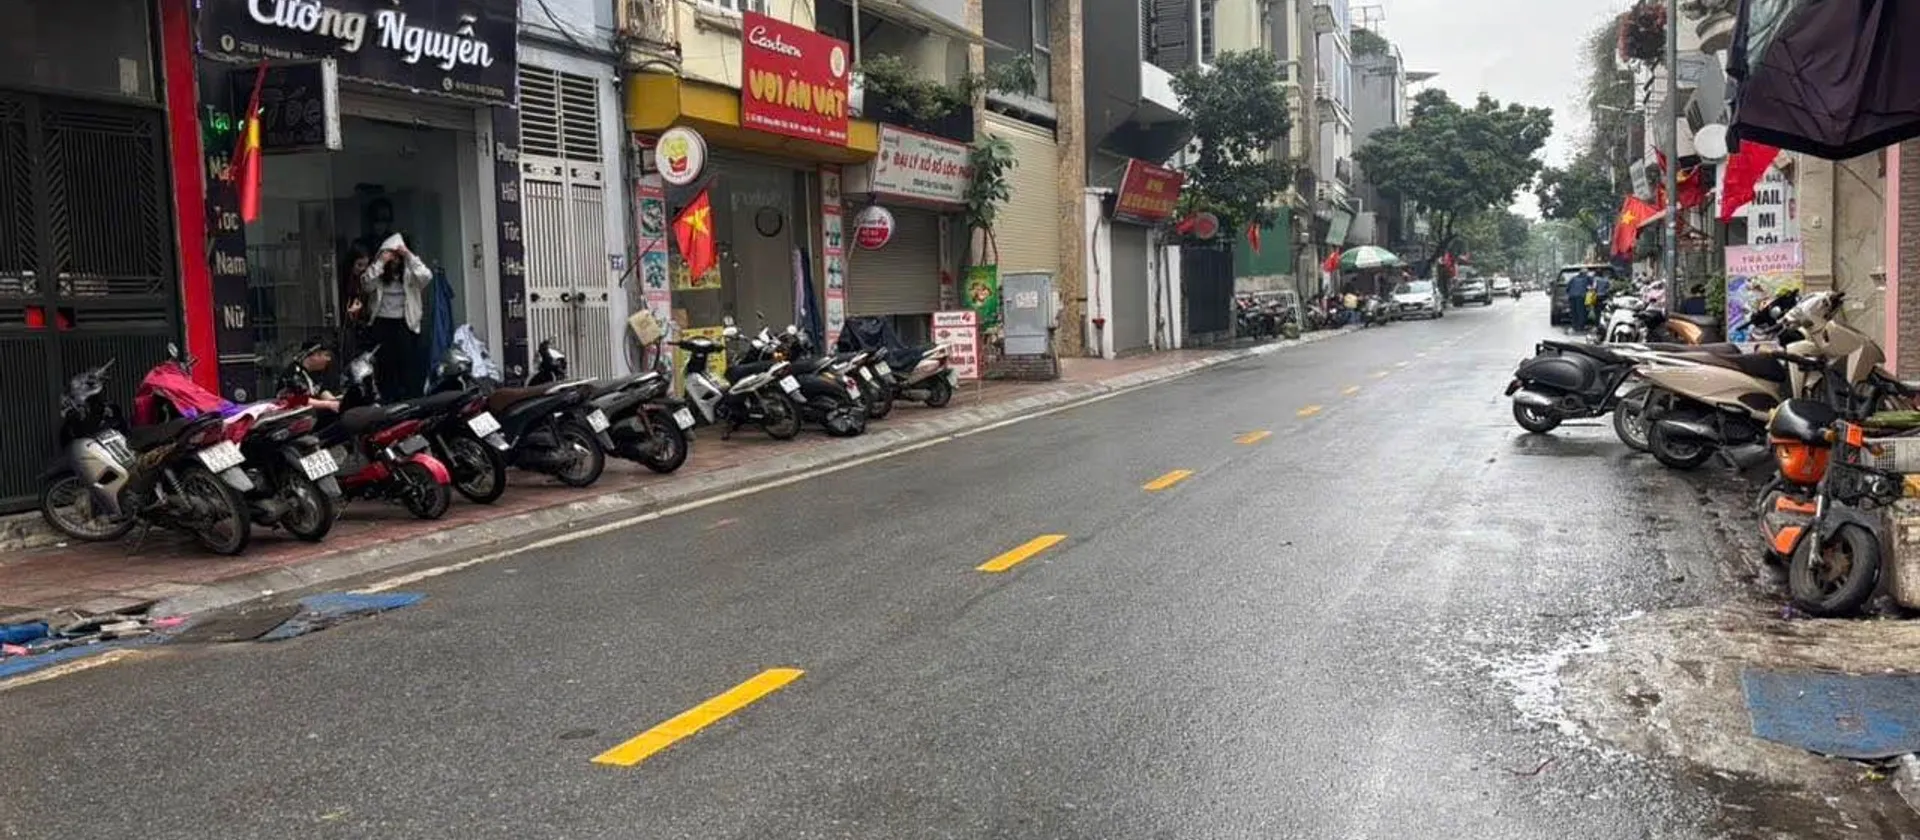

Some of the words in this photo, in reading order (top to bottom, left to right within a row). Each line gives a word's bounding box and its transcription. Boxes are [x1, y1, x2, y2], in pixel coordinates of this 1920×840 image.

[377, 10, 494, 71] Nguyễn
[785, 69, 812, 112] ĂN
[812, 79, 845, 121] VẶT
[1752, 188, 1782, 205] NAIL
[1758, 212, 1776, 229] MI
[215, 250, 246, 276] Nam
